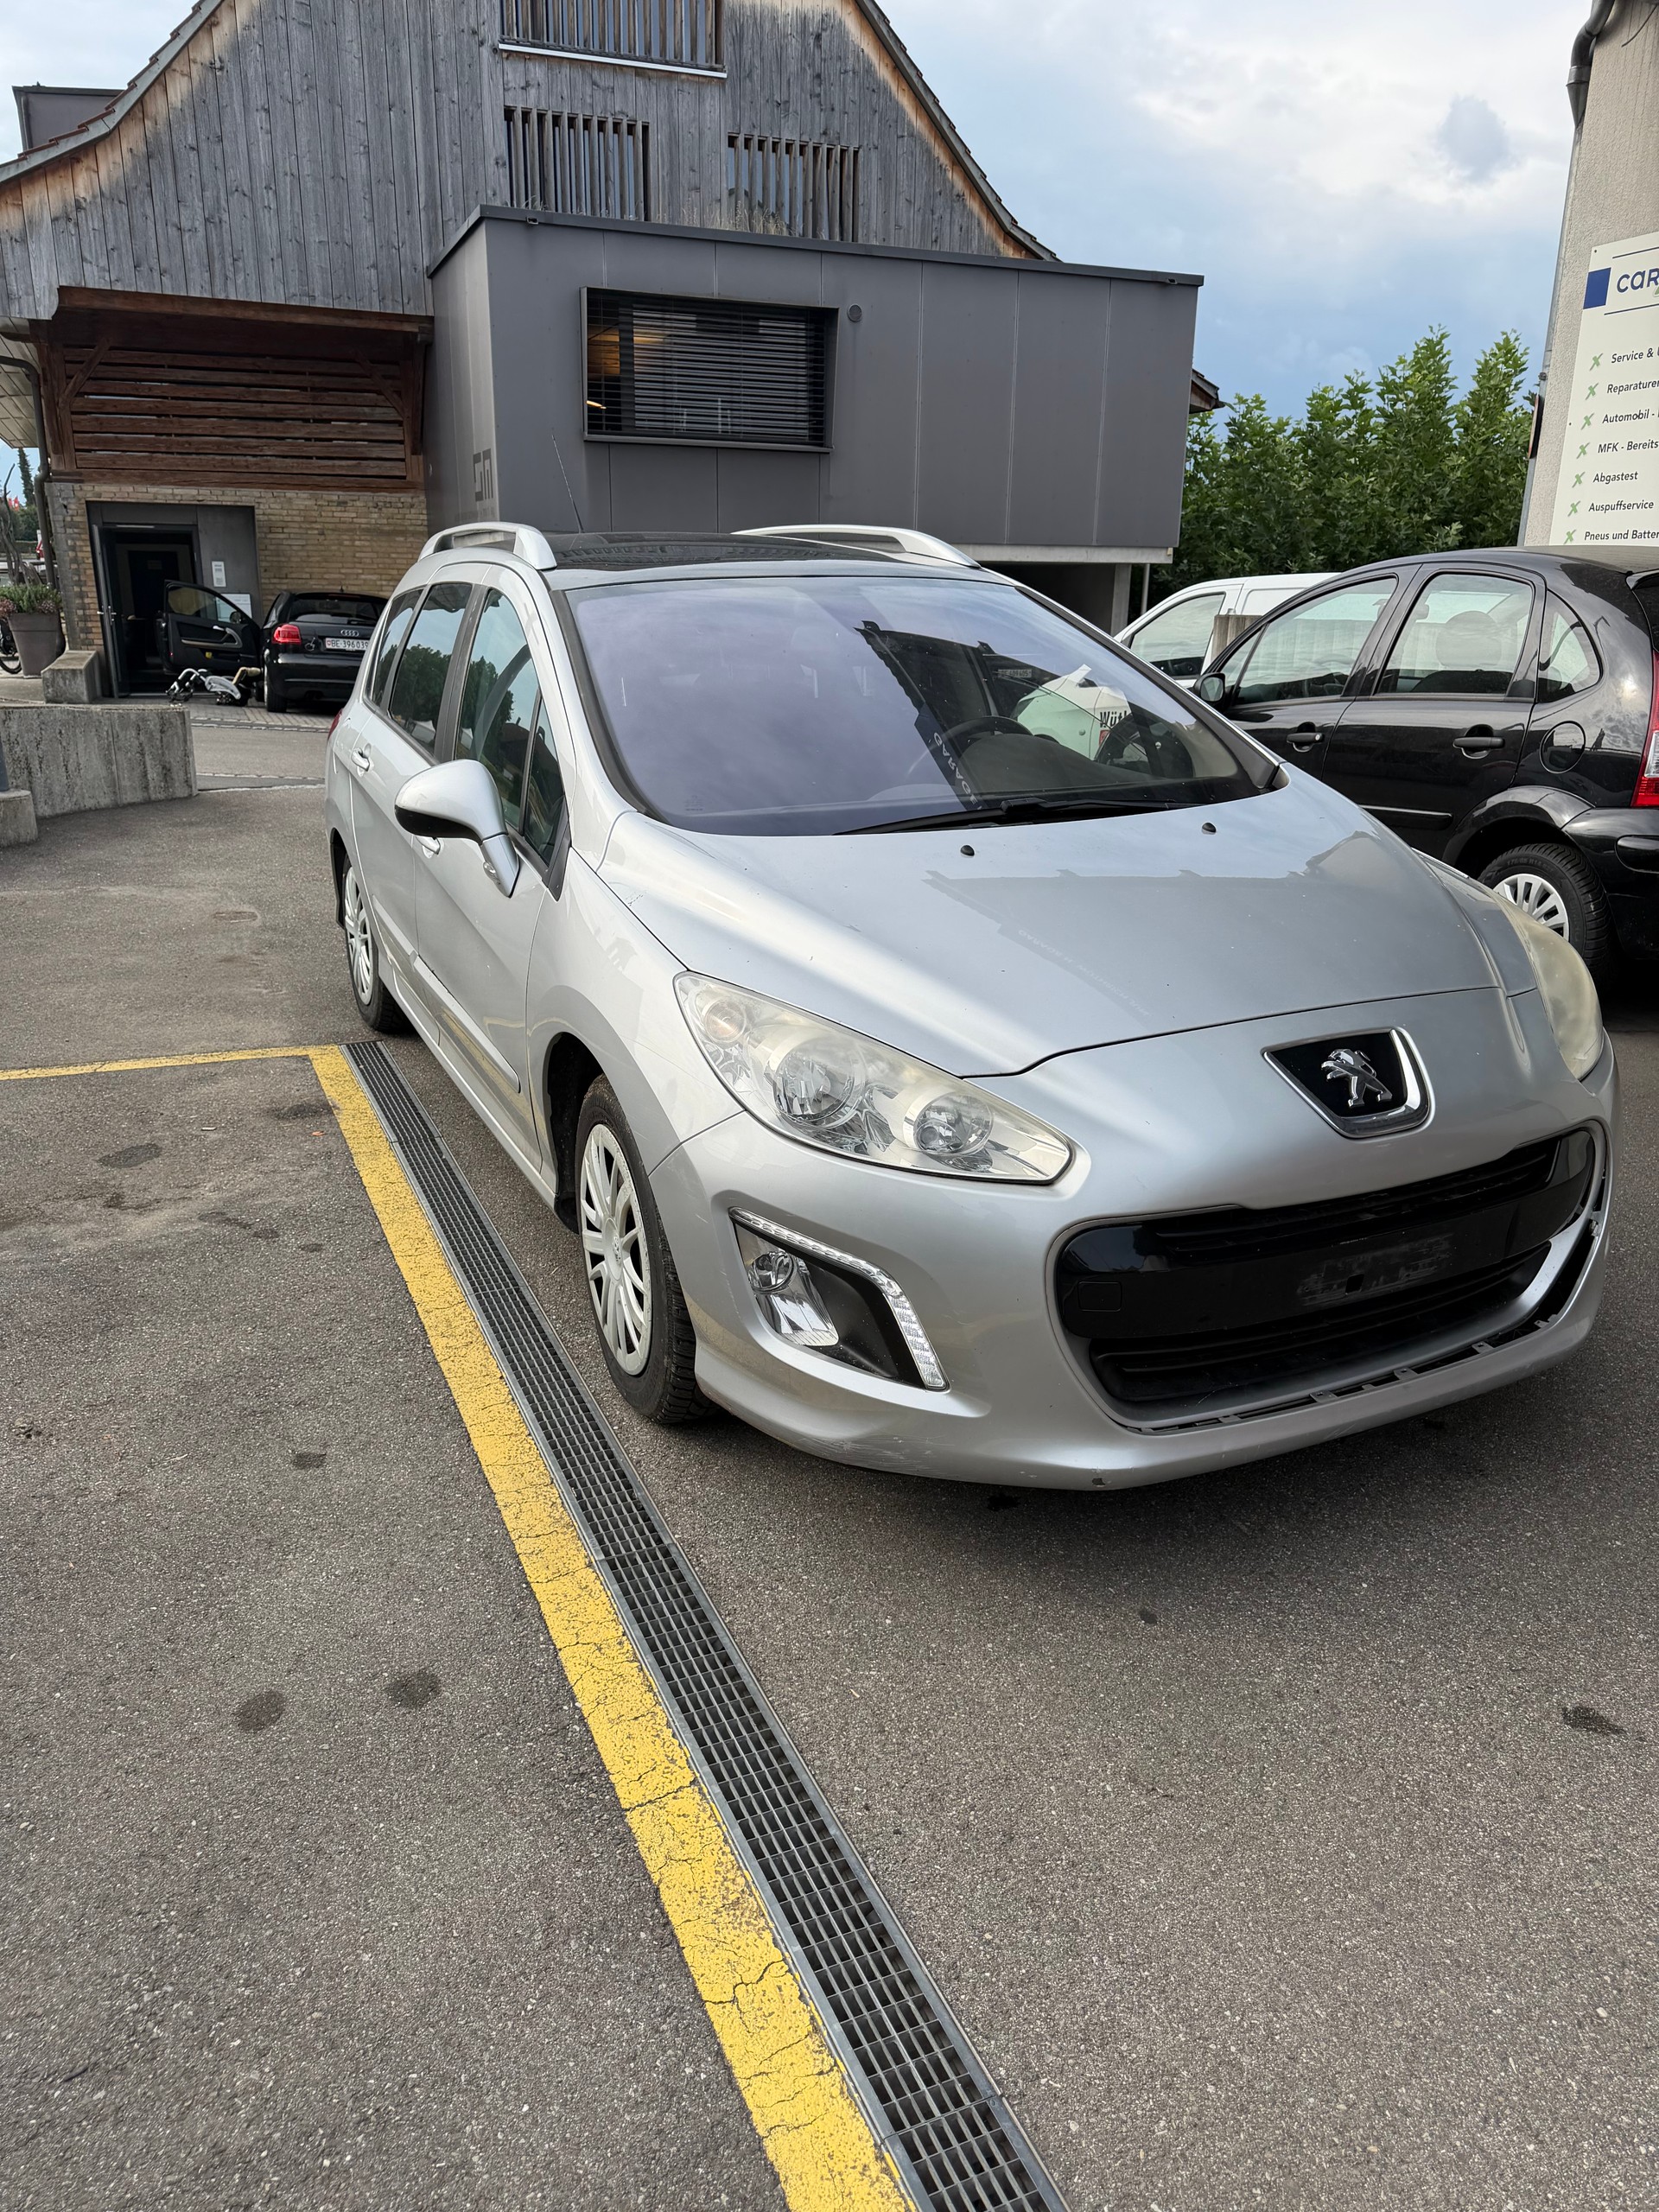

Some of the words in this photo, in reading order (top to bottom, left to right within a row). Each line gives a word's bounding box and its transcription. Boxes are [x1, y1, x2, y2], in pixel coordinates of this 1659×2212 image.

[1611, 350, 1643, 364] Service
[1646, 347, 1654, 359] &
[1602, 409, 1649, 423] Automobil
[1598, 442, 1619, 453] MFK
[1627, 439, 1659, 451] Bereits
[1593, 471, 1638, 484] Abgastest
[1588, 499, 1654, 513] Auspuffservice
[1584, 531, 1610, 541] Pneus
[1611, 530, 1630, 540] und
